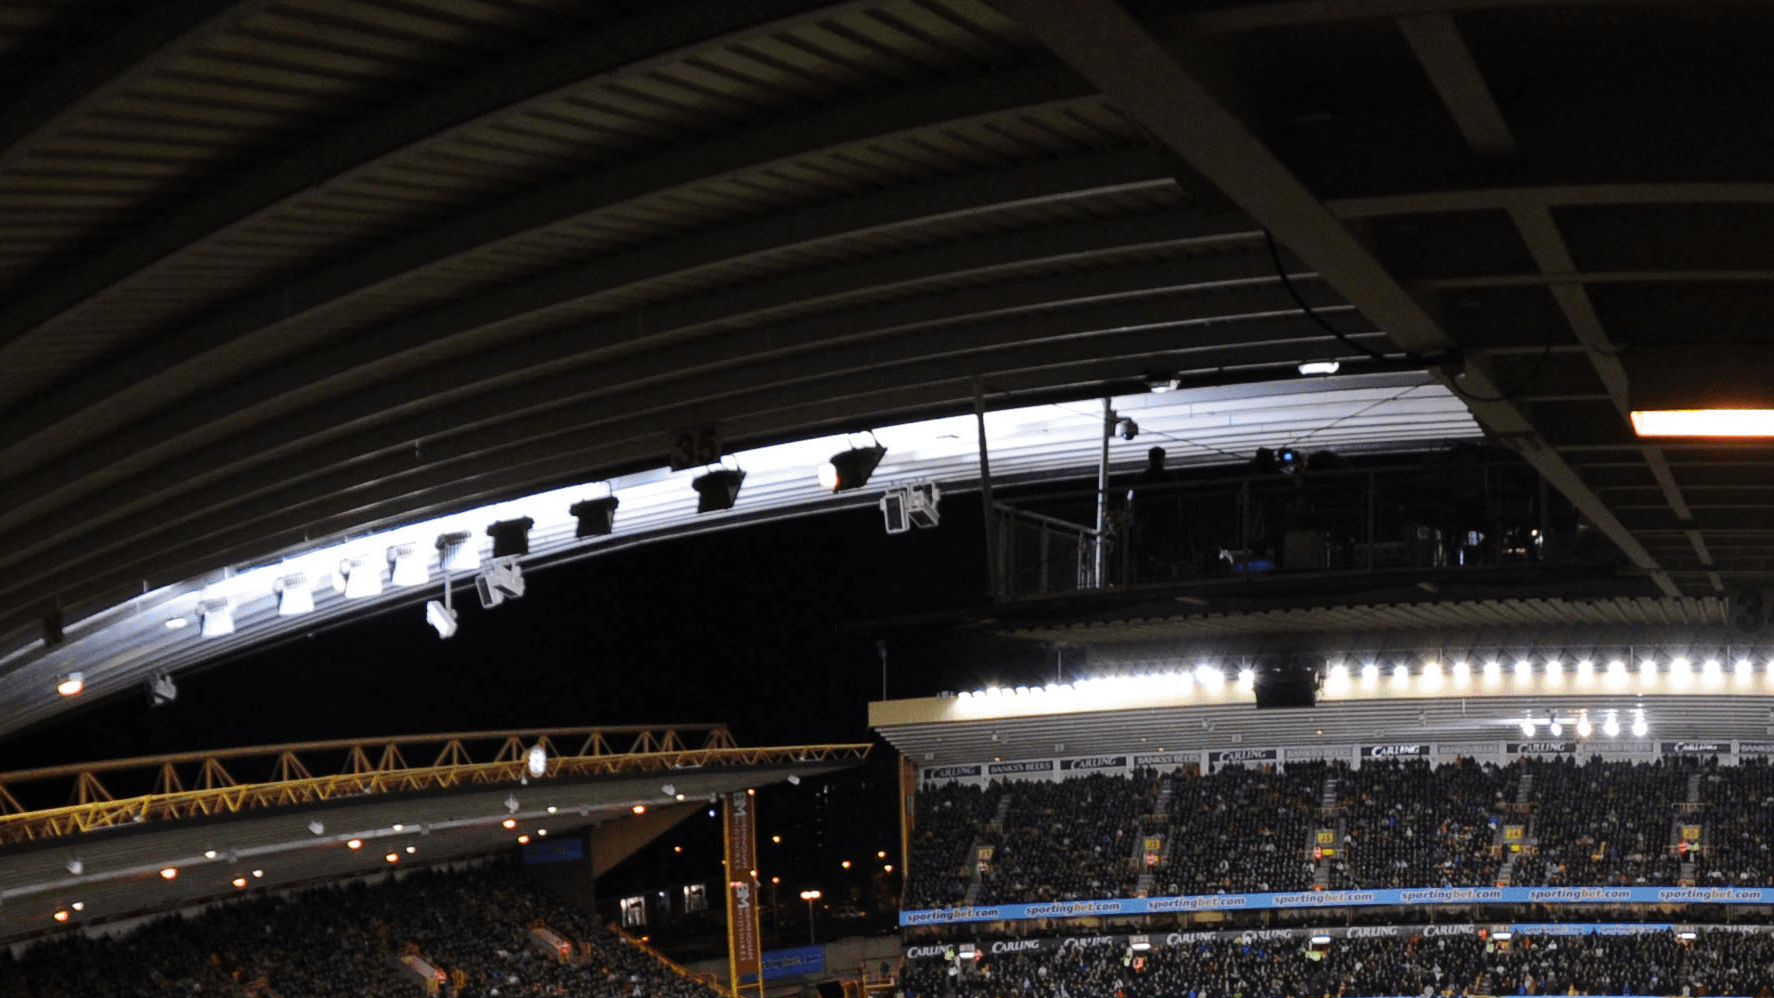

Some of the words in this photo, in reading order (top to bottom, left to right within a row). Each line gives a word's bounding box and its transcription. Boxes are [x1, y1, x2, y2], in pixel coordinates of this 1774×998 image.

[1371, 745, 1420, 757] CARLING
[1274, 891, 1374, 906] sportingbet.com
[1401, 888, 1501, 902] sportingbet.com
[1530, 887, 1630, 900] sportingbet.com
[1660, 888, 1761, 901] sportingbet.com
[1026, 902, 1120, 916] sportingbet.com
[1148, 896, 1246, 910] sportingbet.com
[907, 908, 999, 922] sportingbet.com
[1347, 926, 1398, 939] CARLING
[1424, 925, 1475, 938] CARLING
[992, 940, 1040, 954] CARLING
